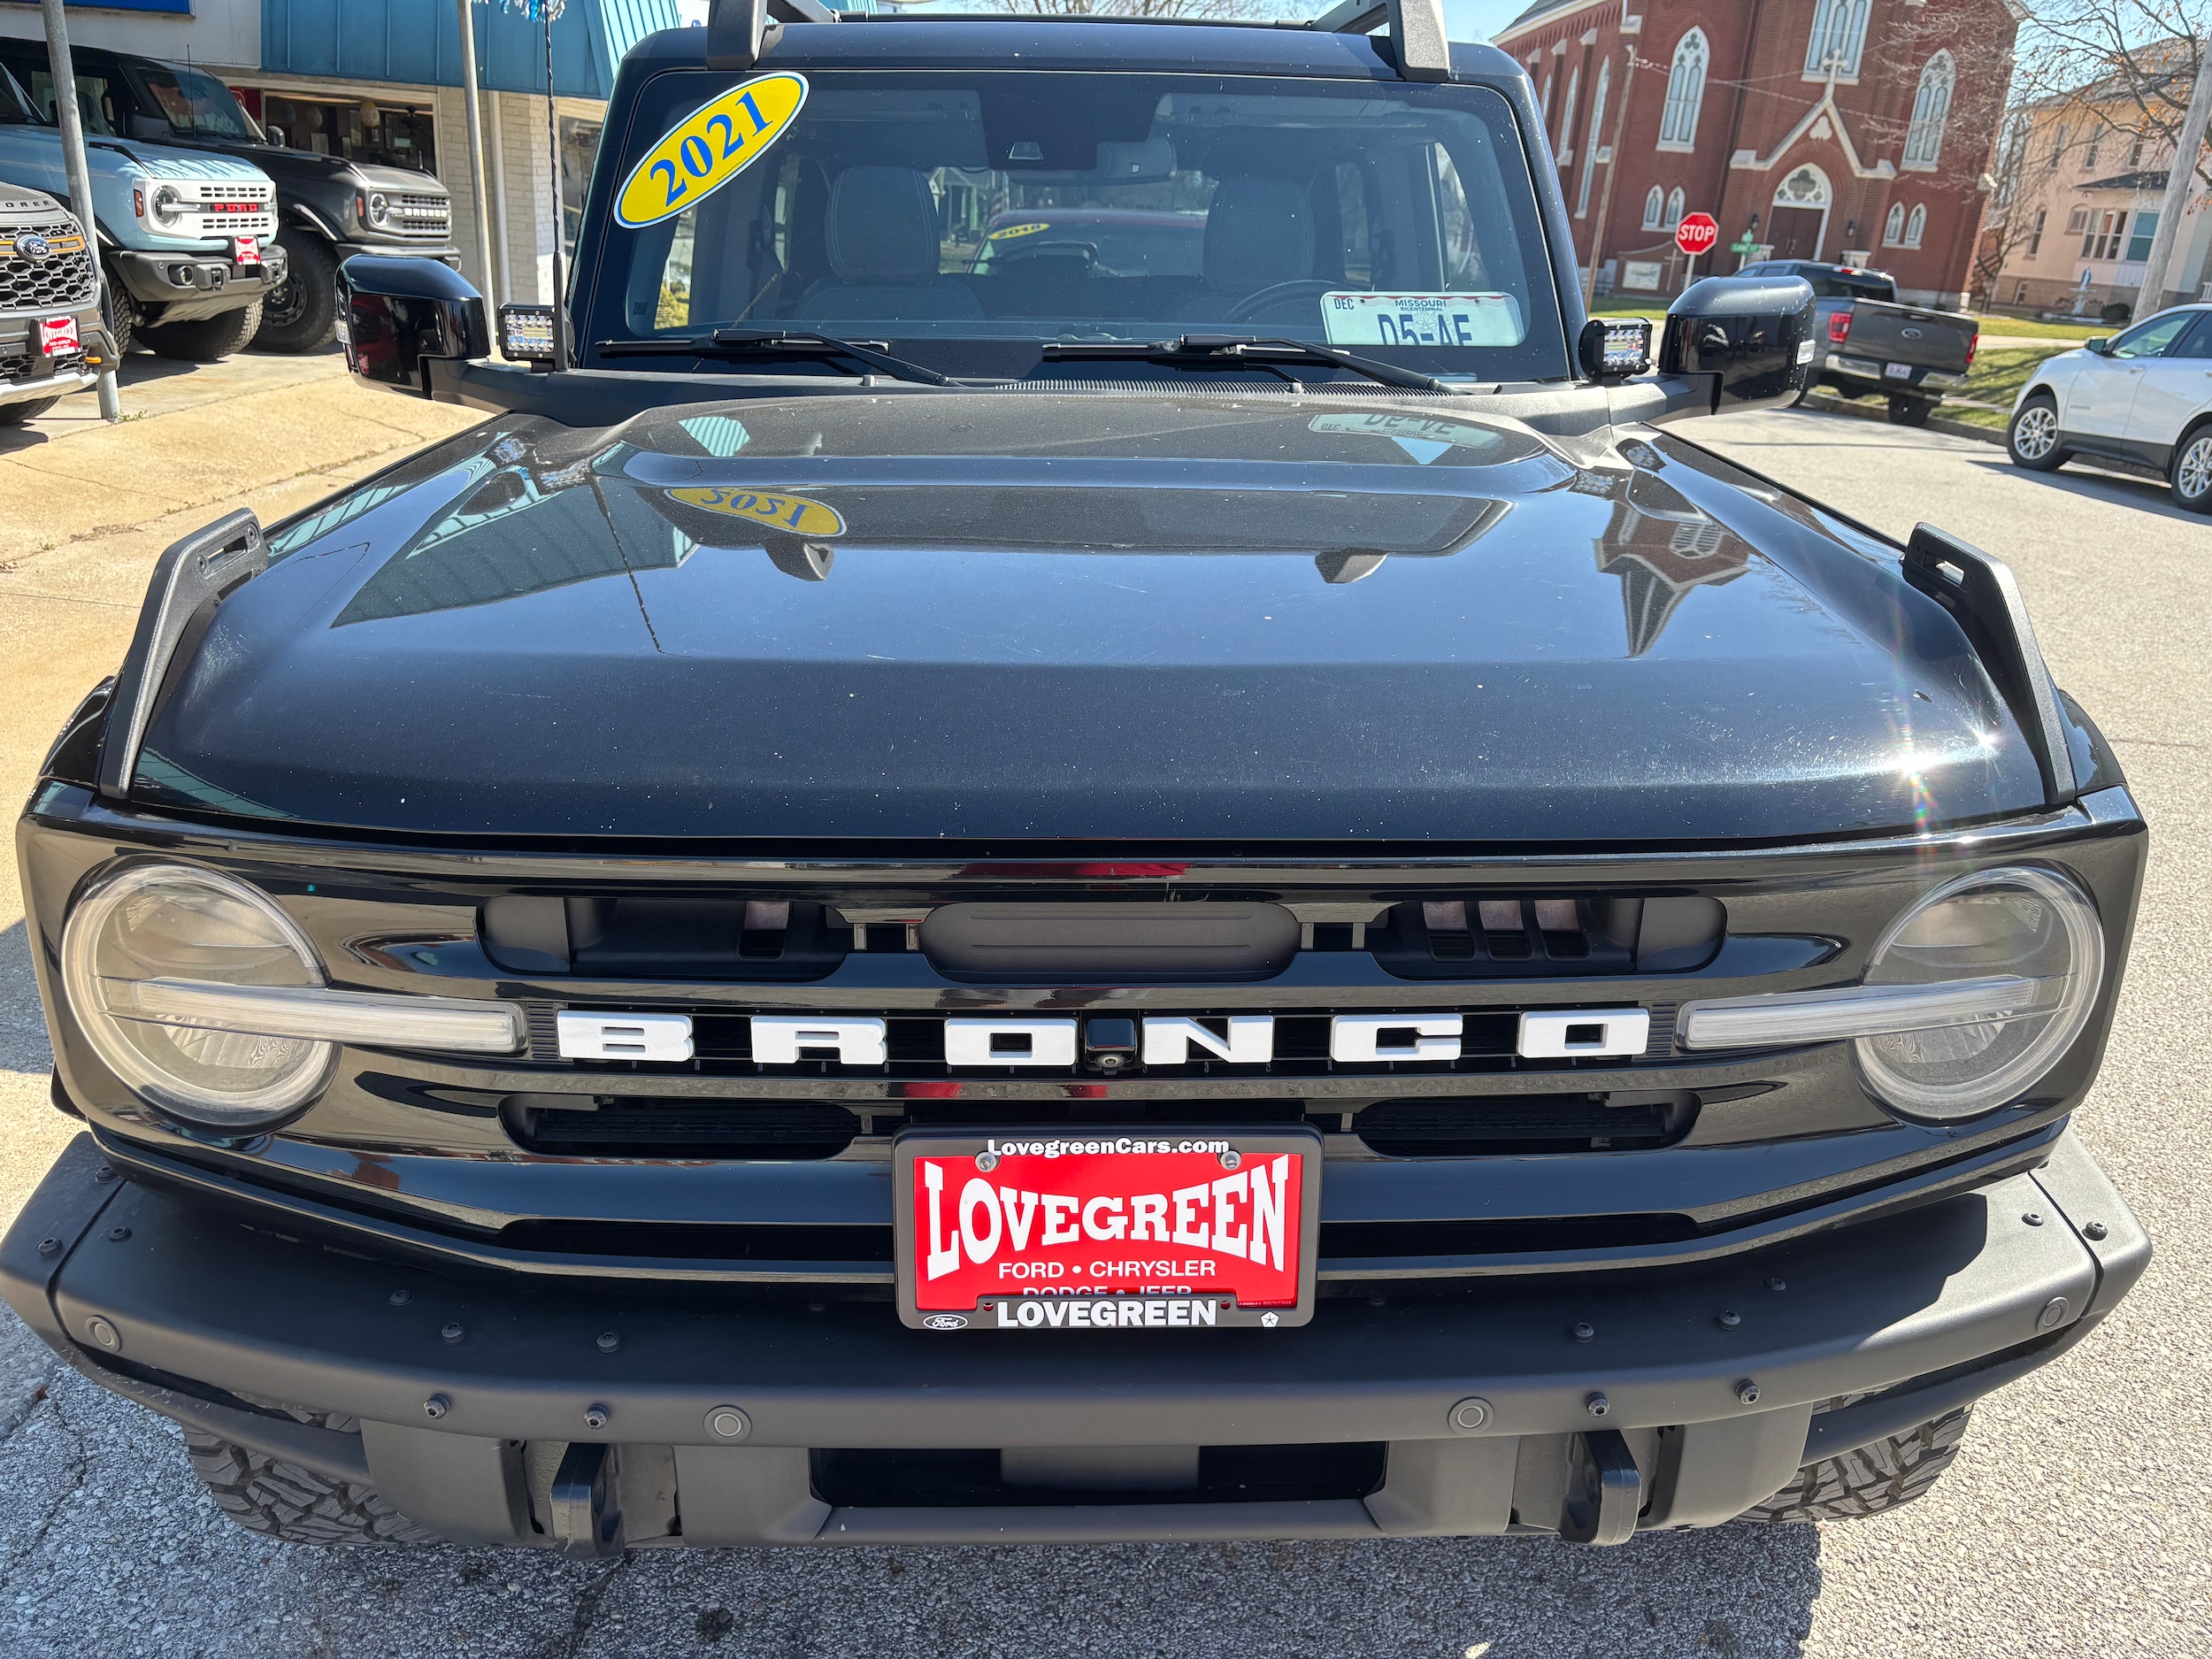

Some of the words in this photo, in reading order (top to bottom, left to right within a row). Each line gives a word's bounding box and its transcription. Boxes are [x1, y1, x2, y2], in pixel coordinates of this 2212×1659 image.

[649, 90, 773, 207] 2021
[213, 203, 259, 212] FORD
[1678, 224, 1715, 242] STOP
[1333, 297, 1355, 311] DEC
[557, 1010, 1650, 1065] BRONCO
[987, 1138, 1230, 1158] LovegreenCars.com
[925, 1153, 1289, 1281] LOVEGREEN
[998, 1262, 1064, 1279] FORD
[1089, 1260, 1217, 1278] CHRYSLER
[932, 1317, 960, 1328] Ford
[997, 1300, 1217, 1327] LOVEGREEN
